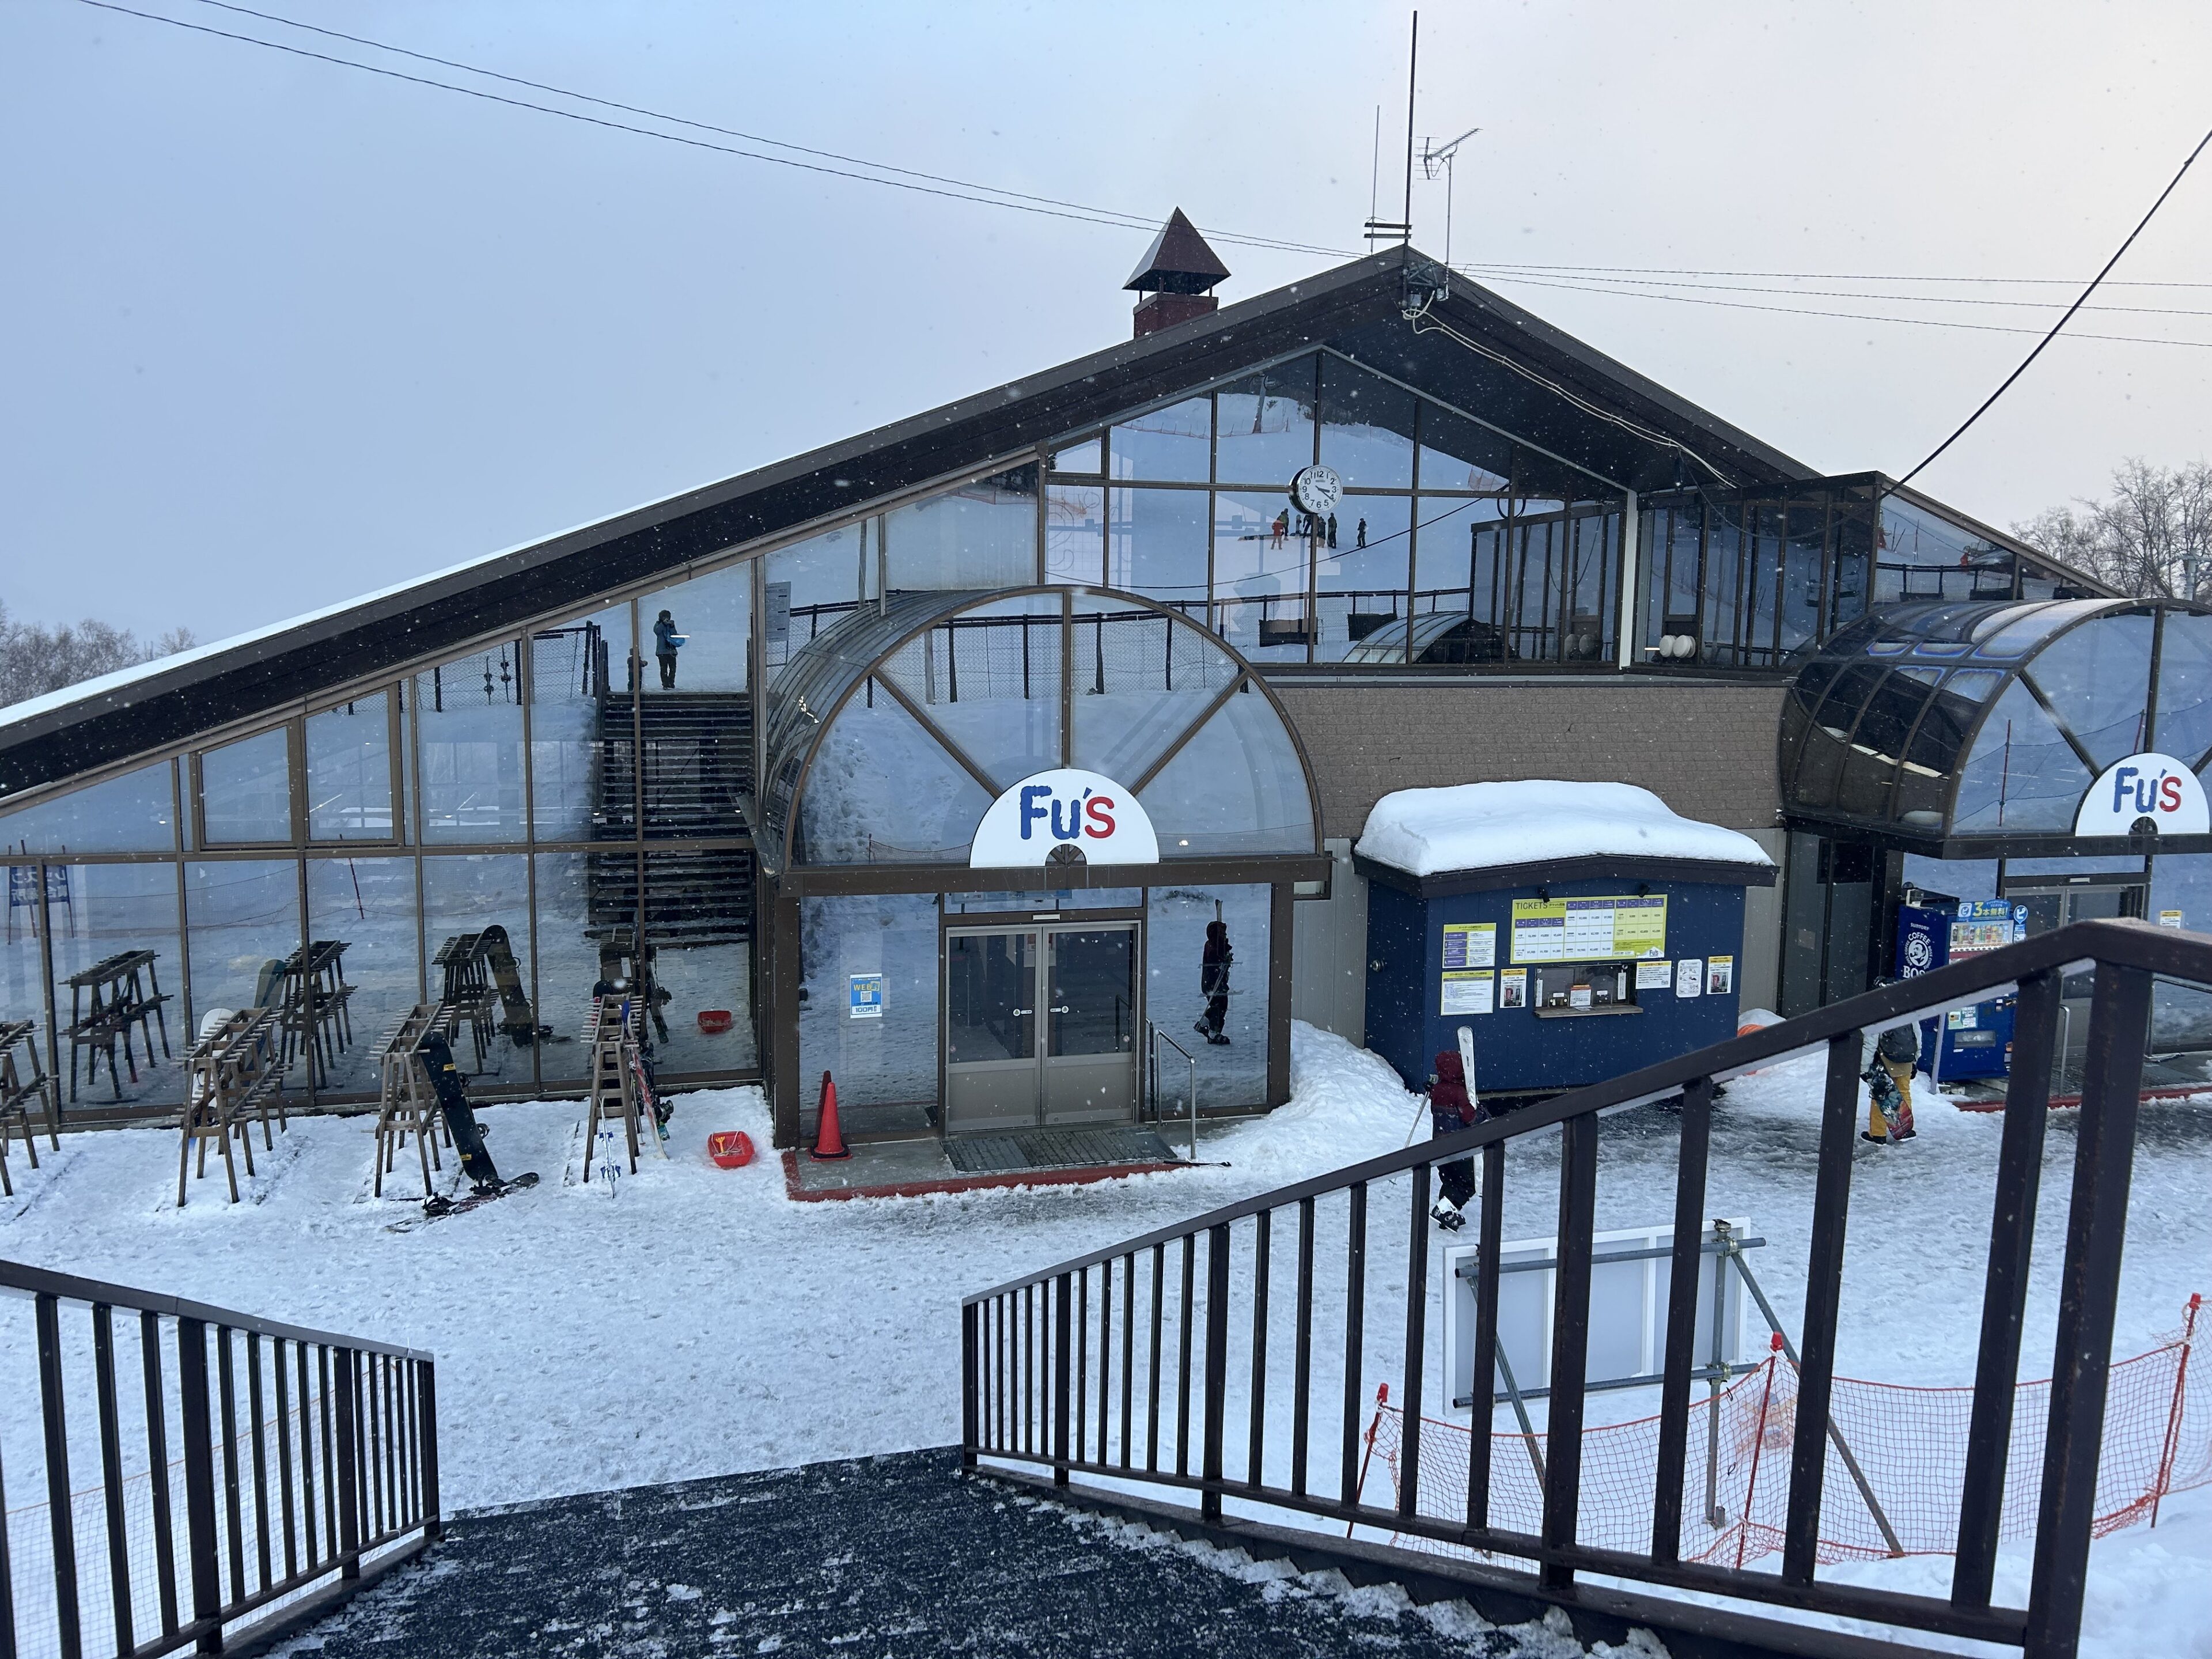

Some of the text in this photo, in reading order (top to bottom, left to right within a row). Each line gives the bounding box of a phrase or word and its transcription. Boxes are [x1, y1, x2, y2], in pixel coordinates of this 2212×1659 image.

[1020, 785, 1116, 840] Fu's
[2113, 767, 2183, 813] Fu's
[1908, 931, 1931, 945] COFFEE
